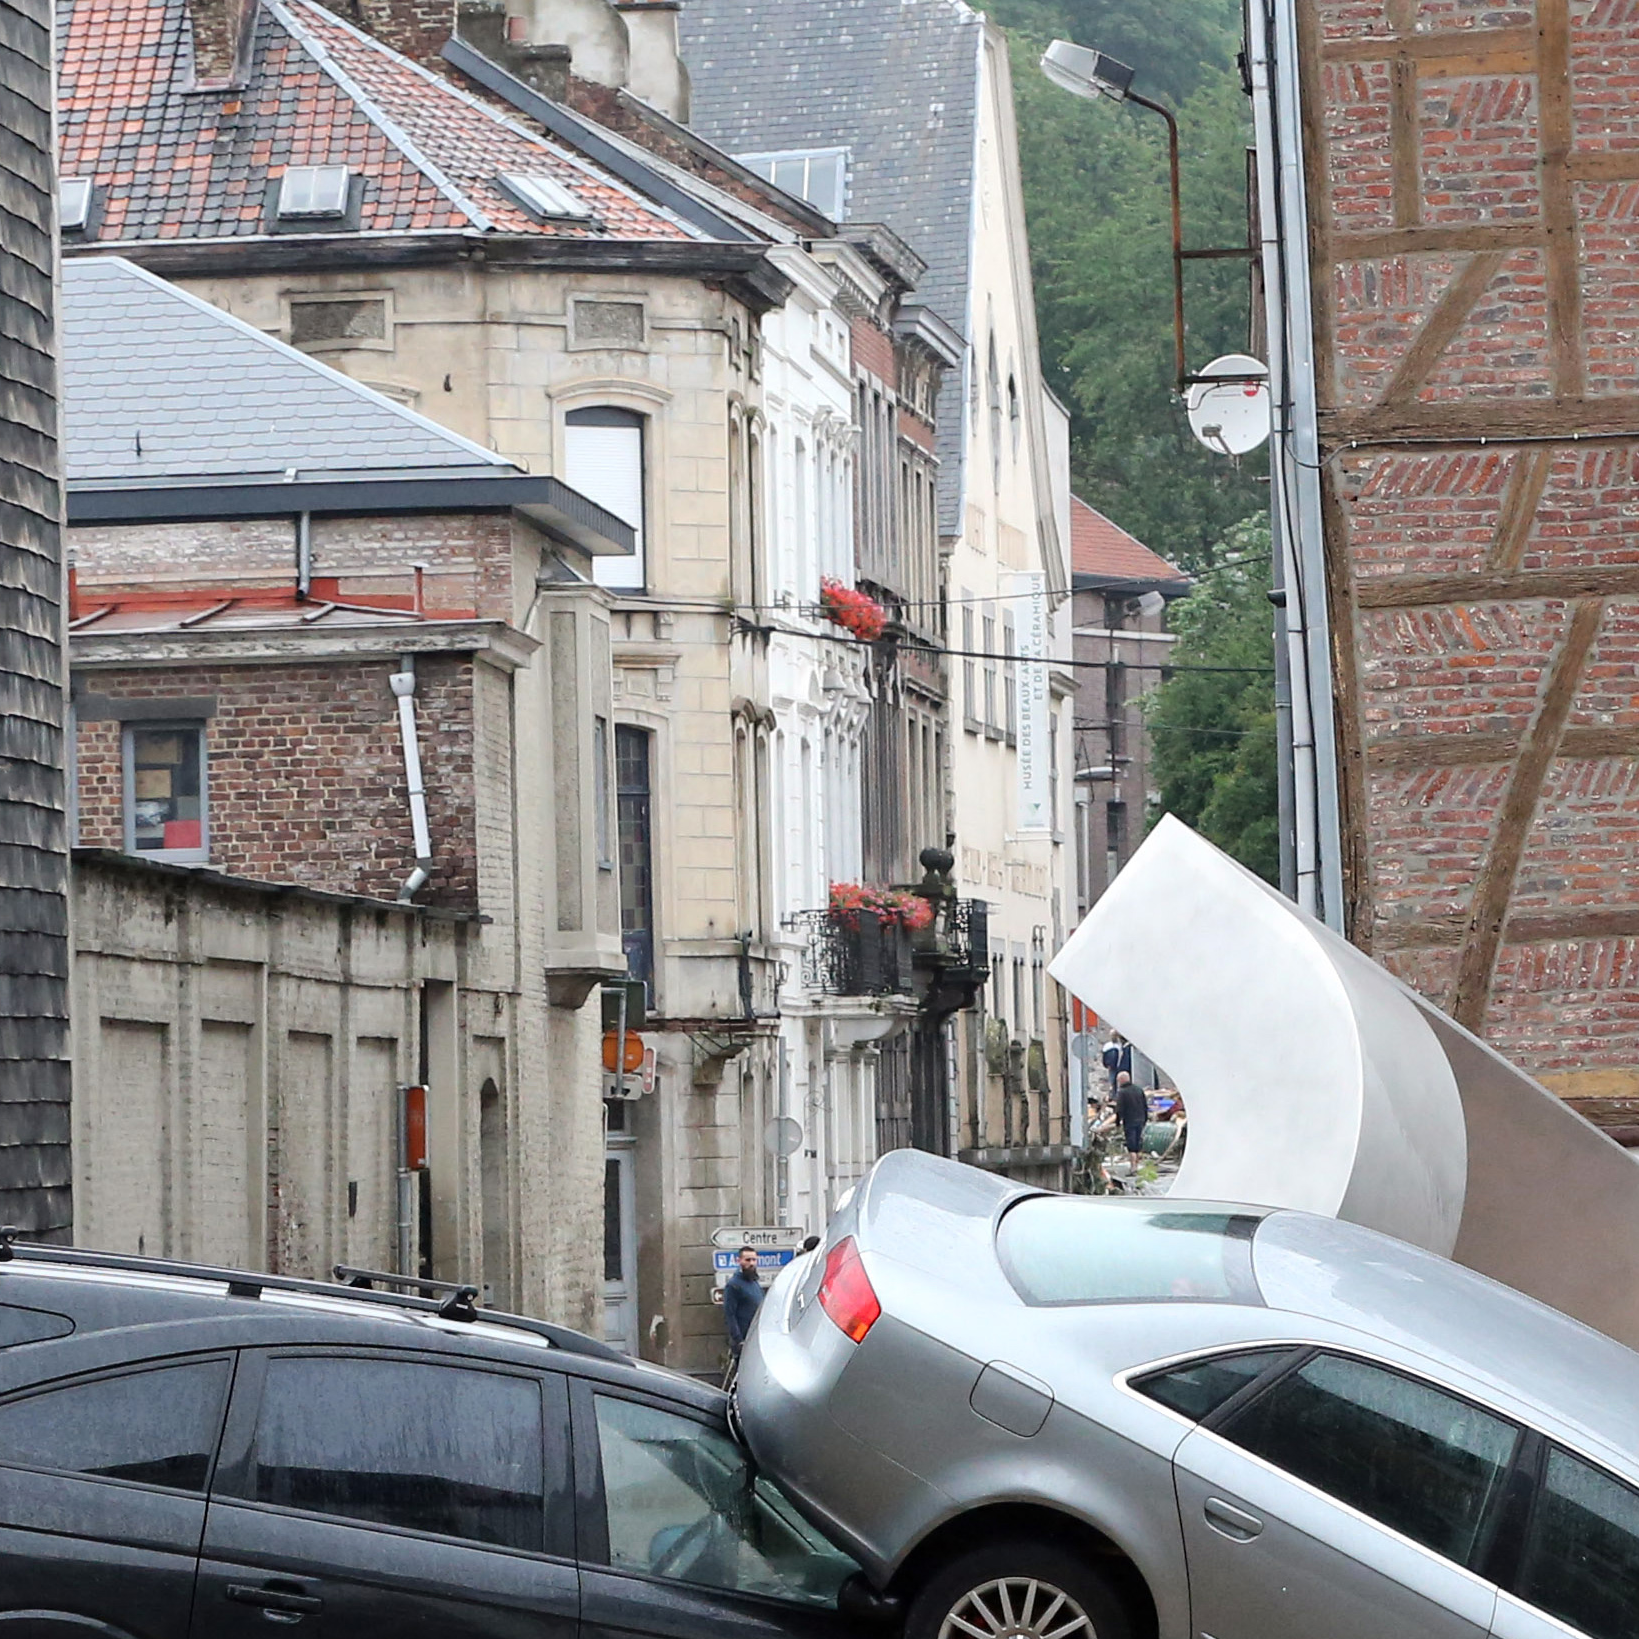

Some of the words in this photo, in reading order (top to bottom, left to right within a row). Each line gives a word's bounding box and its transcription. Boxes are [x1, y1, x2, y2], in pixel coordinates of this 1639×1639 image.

[1032, 667, 1042, 683] DE
[1033, 687, 1043, 701] ET
[1021, 722, 1031, 747] DES
[1021, 750, 1032, 790] MUSÉE
[742, 1231, 777, 1244] Centre
